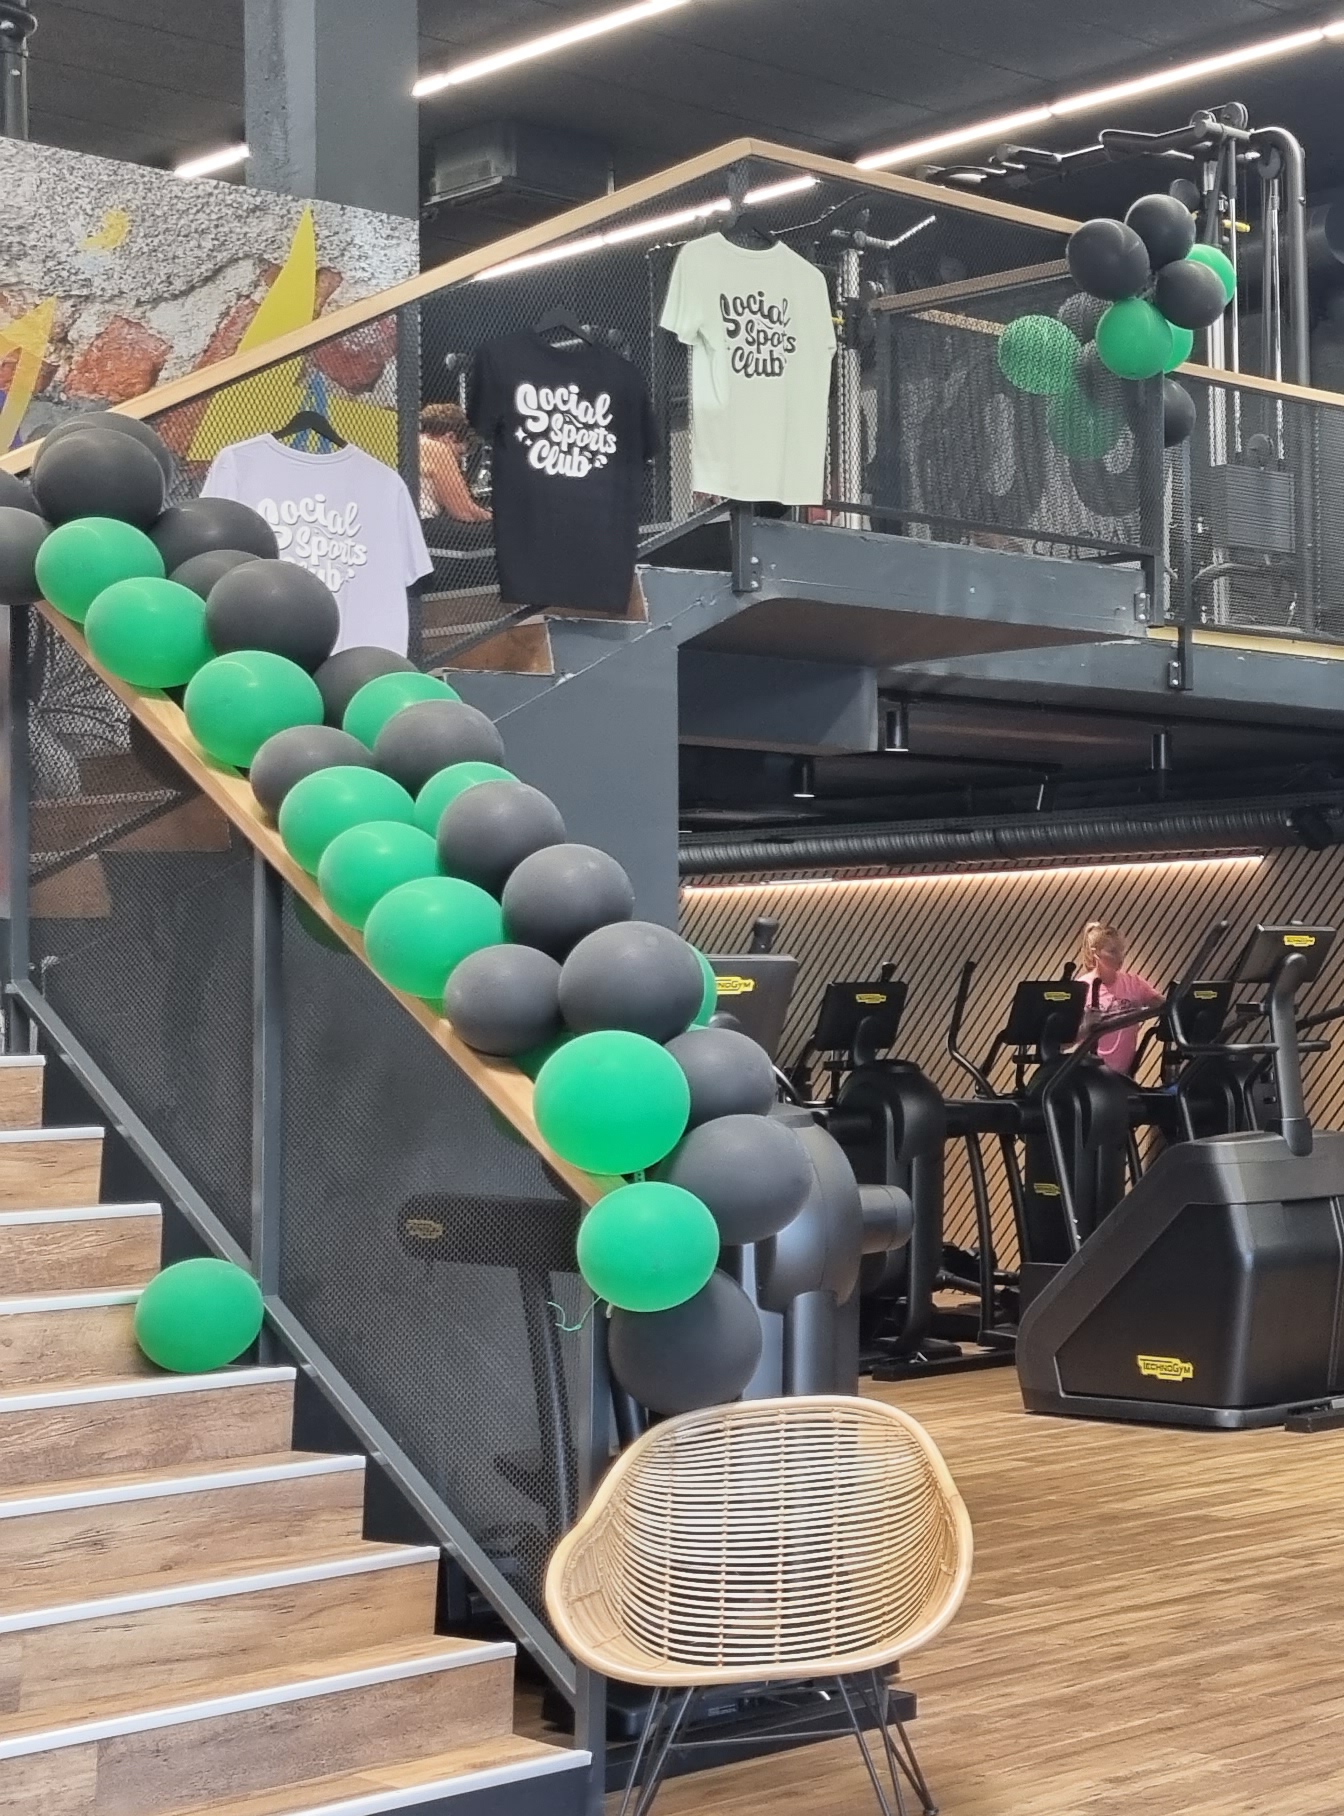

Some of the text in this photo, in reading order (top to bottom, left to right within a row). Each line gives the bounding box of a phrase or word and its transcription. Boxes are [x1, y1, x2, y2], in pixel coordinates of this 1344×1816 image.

[720, 290, 791, 340] Social
[745, 319, 797, 354] Spots
[731, 346, 784, 379] Club
[516, 383, 614, 433] Social
[550, 413, 617, 454] Sports
[529, 439, 593, 478] Club
[295, 525, 368, 567] Sports
[716, 979, 752, 991] NOGYM
